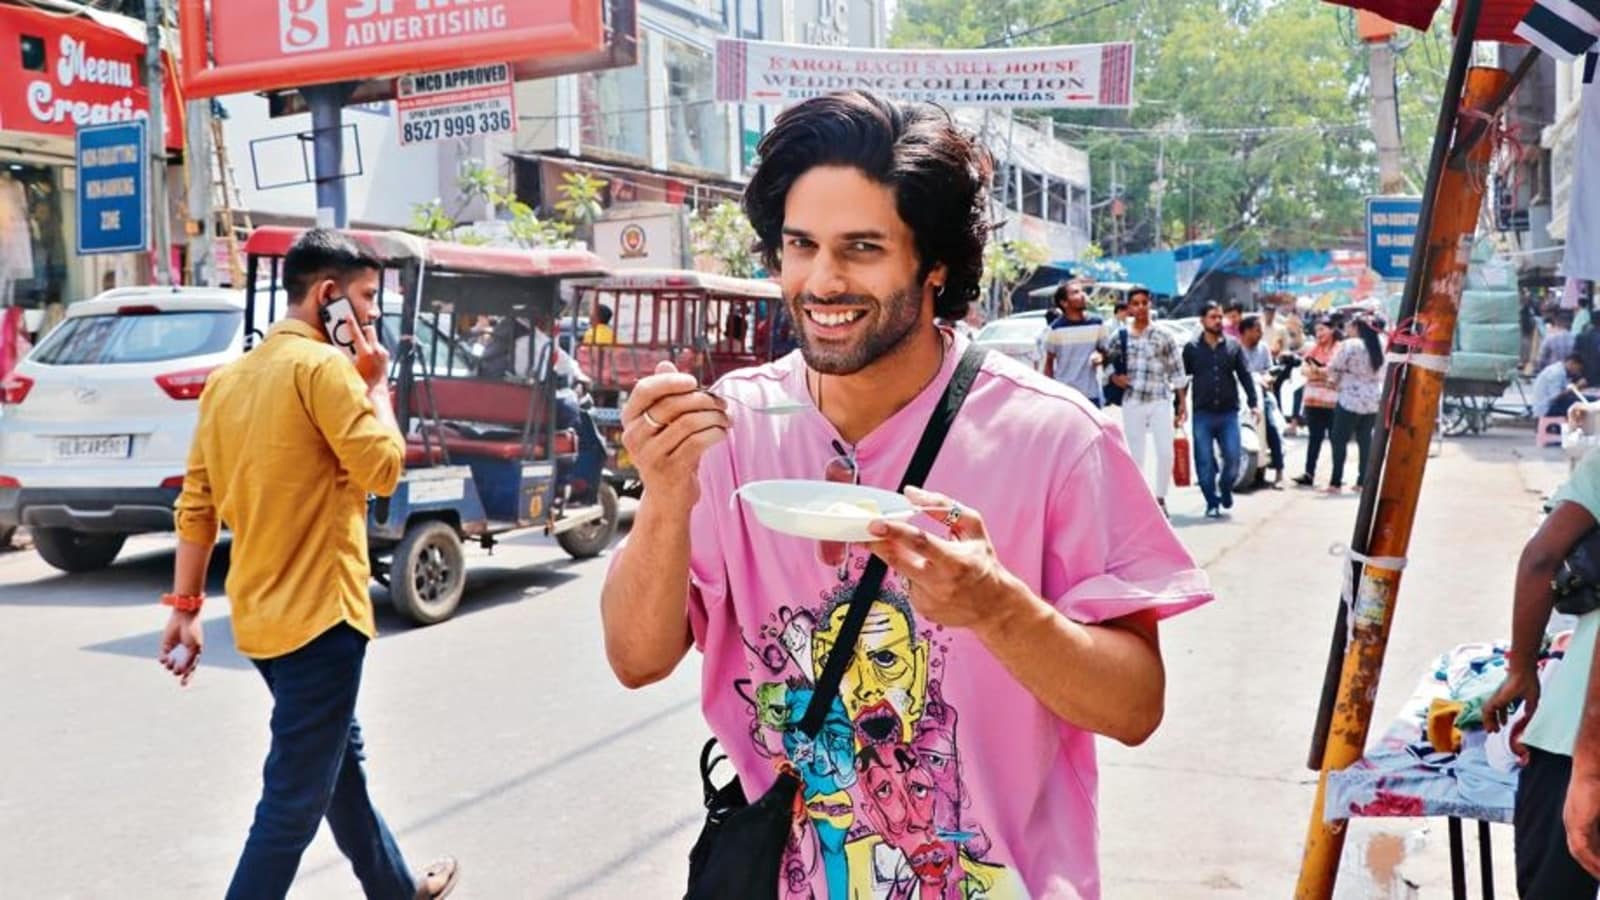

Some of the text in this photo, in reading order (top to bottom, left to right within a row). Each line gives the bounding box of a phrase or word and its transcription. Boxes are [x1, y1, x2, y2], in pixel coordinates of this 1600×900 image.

[345, 5, 506, 47] ADVERTISING
[57, 33, 133, 88] Meenu
[1005, 58, 1081, 74] HOUSE
[445, 64, 506, 89] APPROVED
[762, 73, 1086, 90] WEDDING COLLECTION
[951, 92, 1056, 102] LEHANGAS
[403, 110, 511, 143] 8527 999 336
